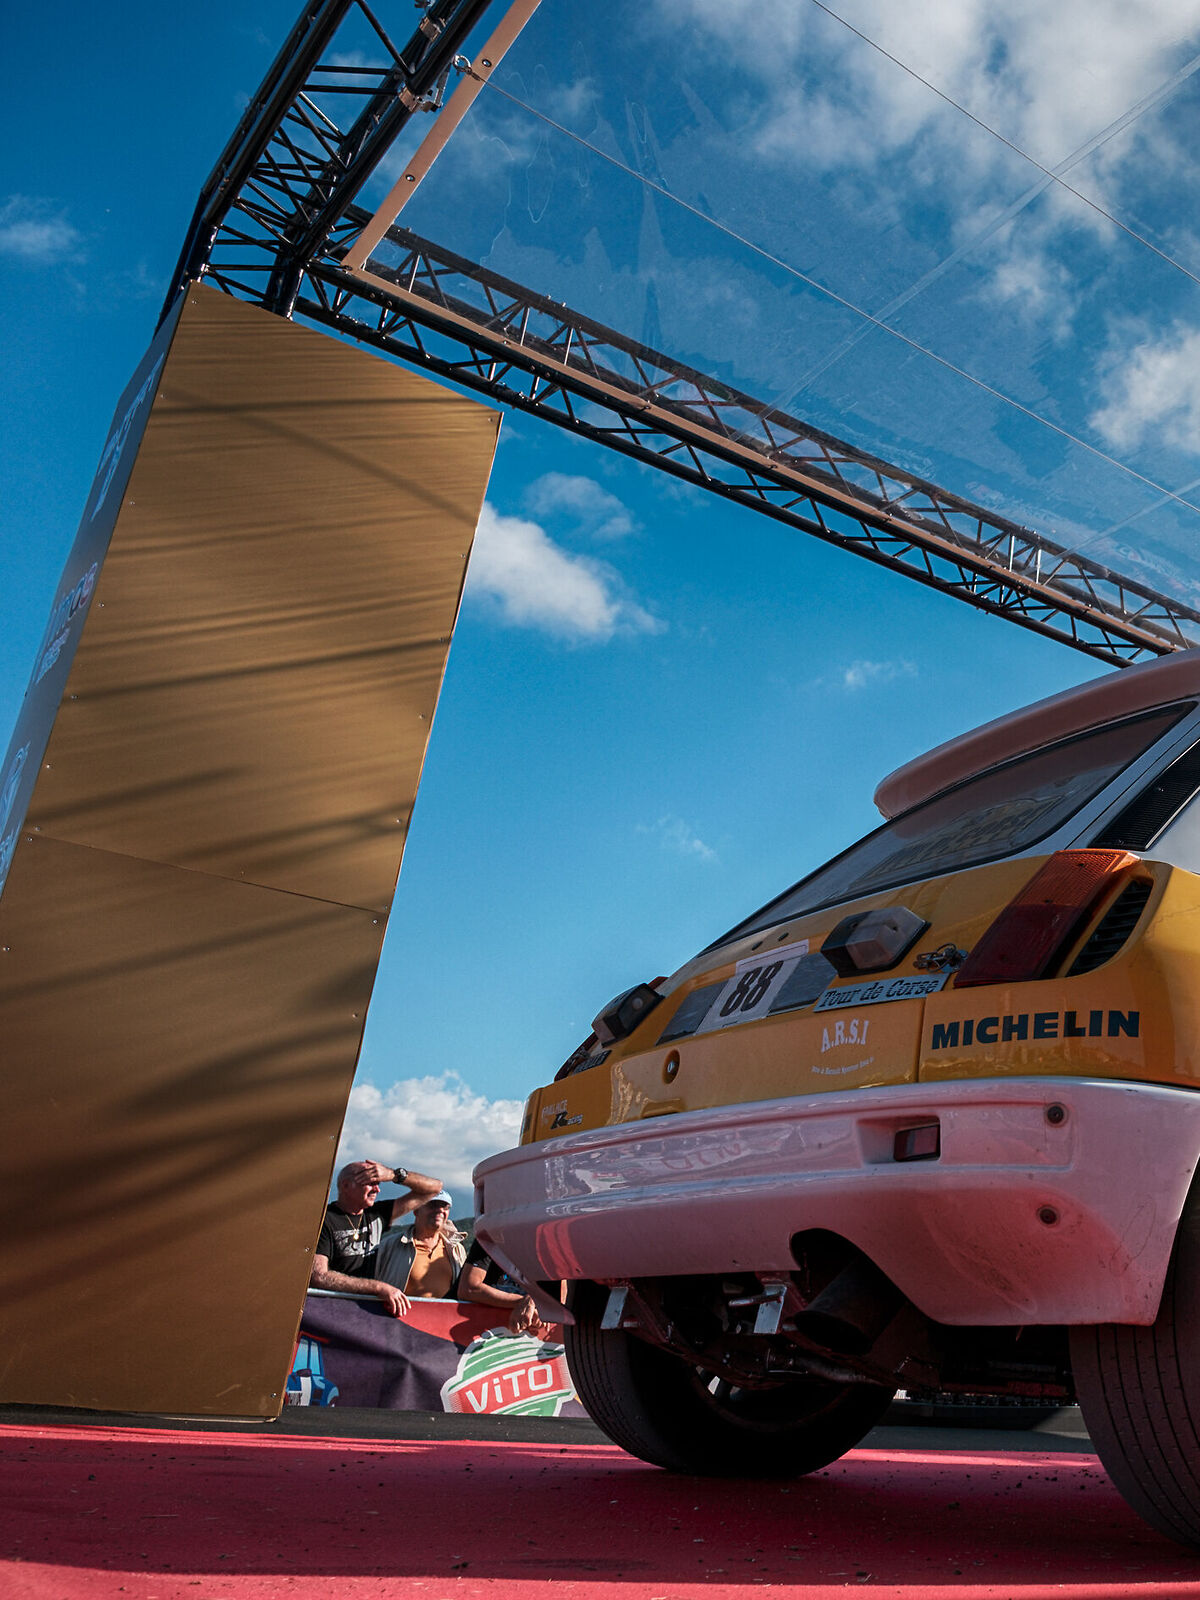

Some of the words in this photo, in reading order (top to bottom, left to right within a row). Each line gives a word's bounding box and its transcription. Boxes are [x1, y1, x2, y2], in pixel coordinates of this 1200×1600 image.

[719, 960, 784, 1017] 88
[819, 988, 859, 1009] Tour
[860, 982, 882, 1000] de
[885, 979, 942, 999] Corse
[931, 1010, 1140, 1050] MICHELIN
